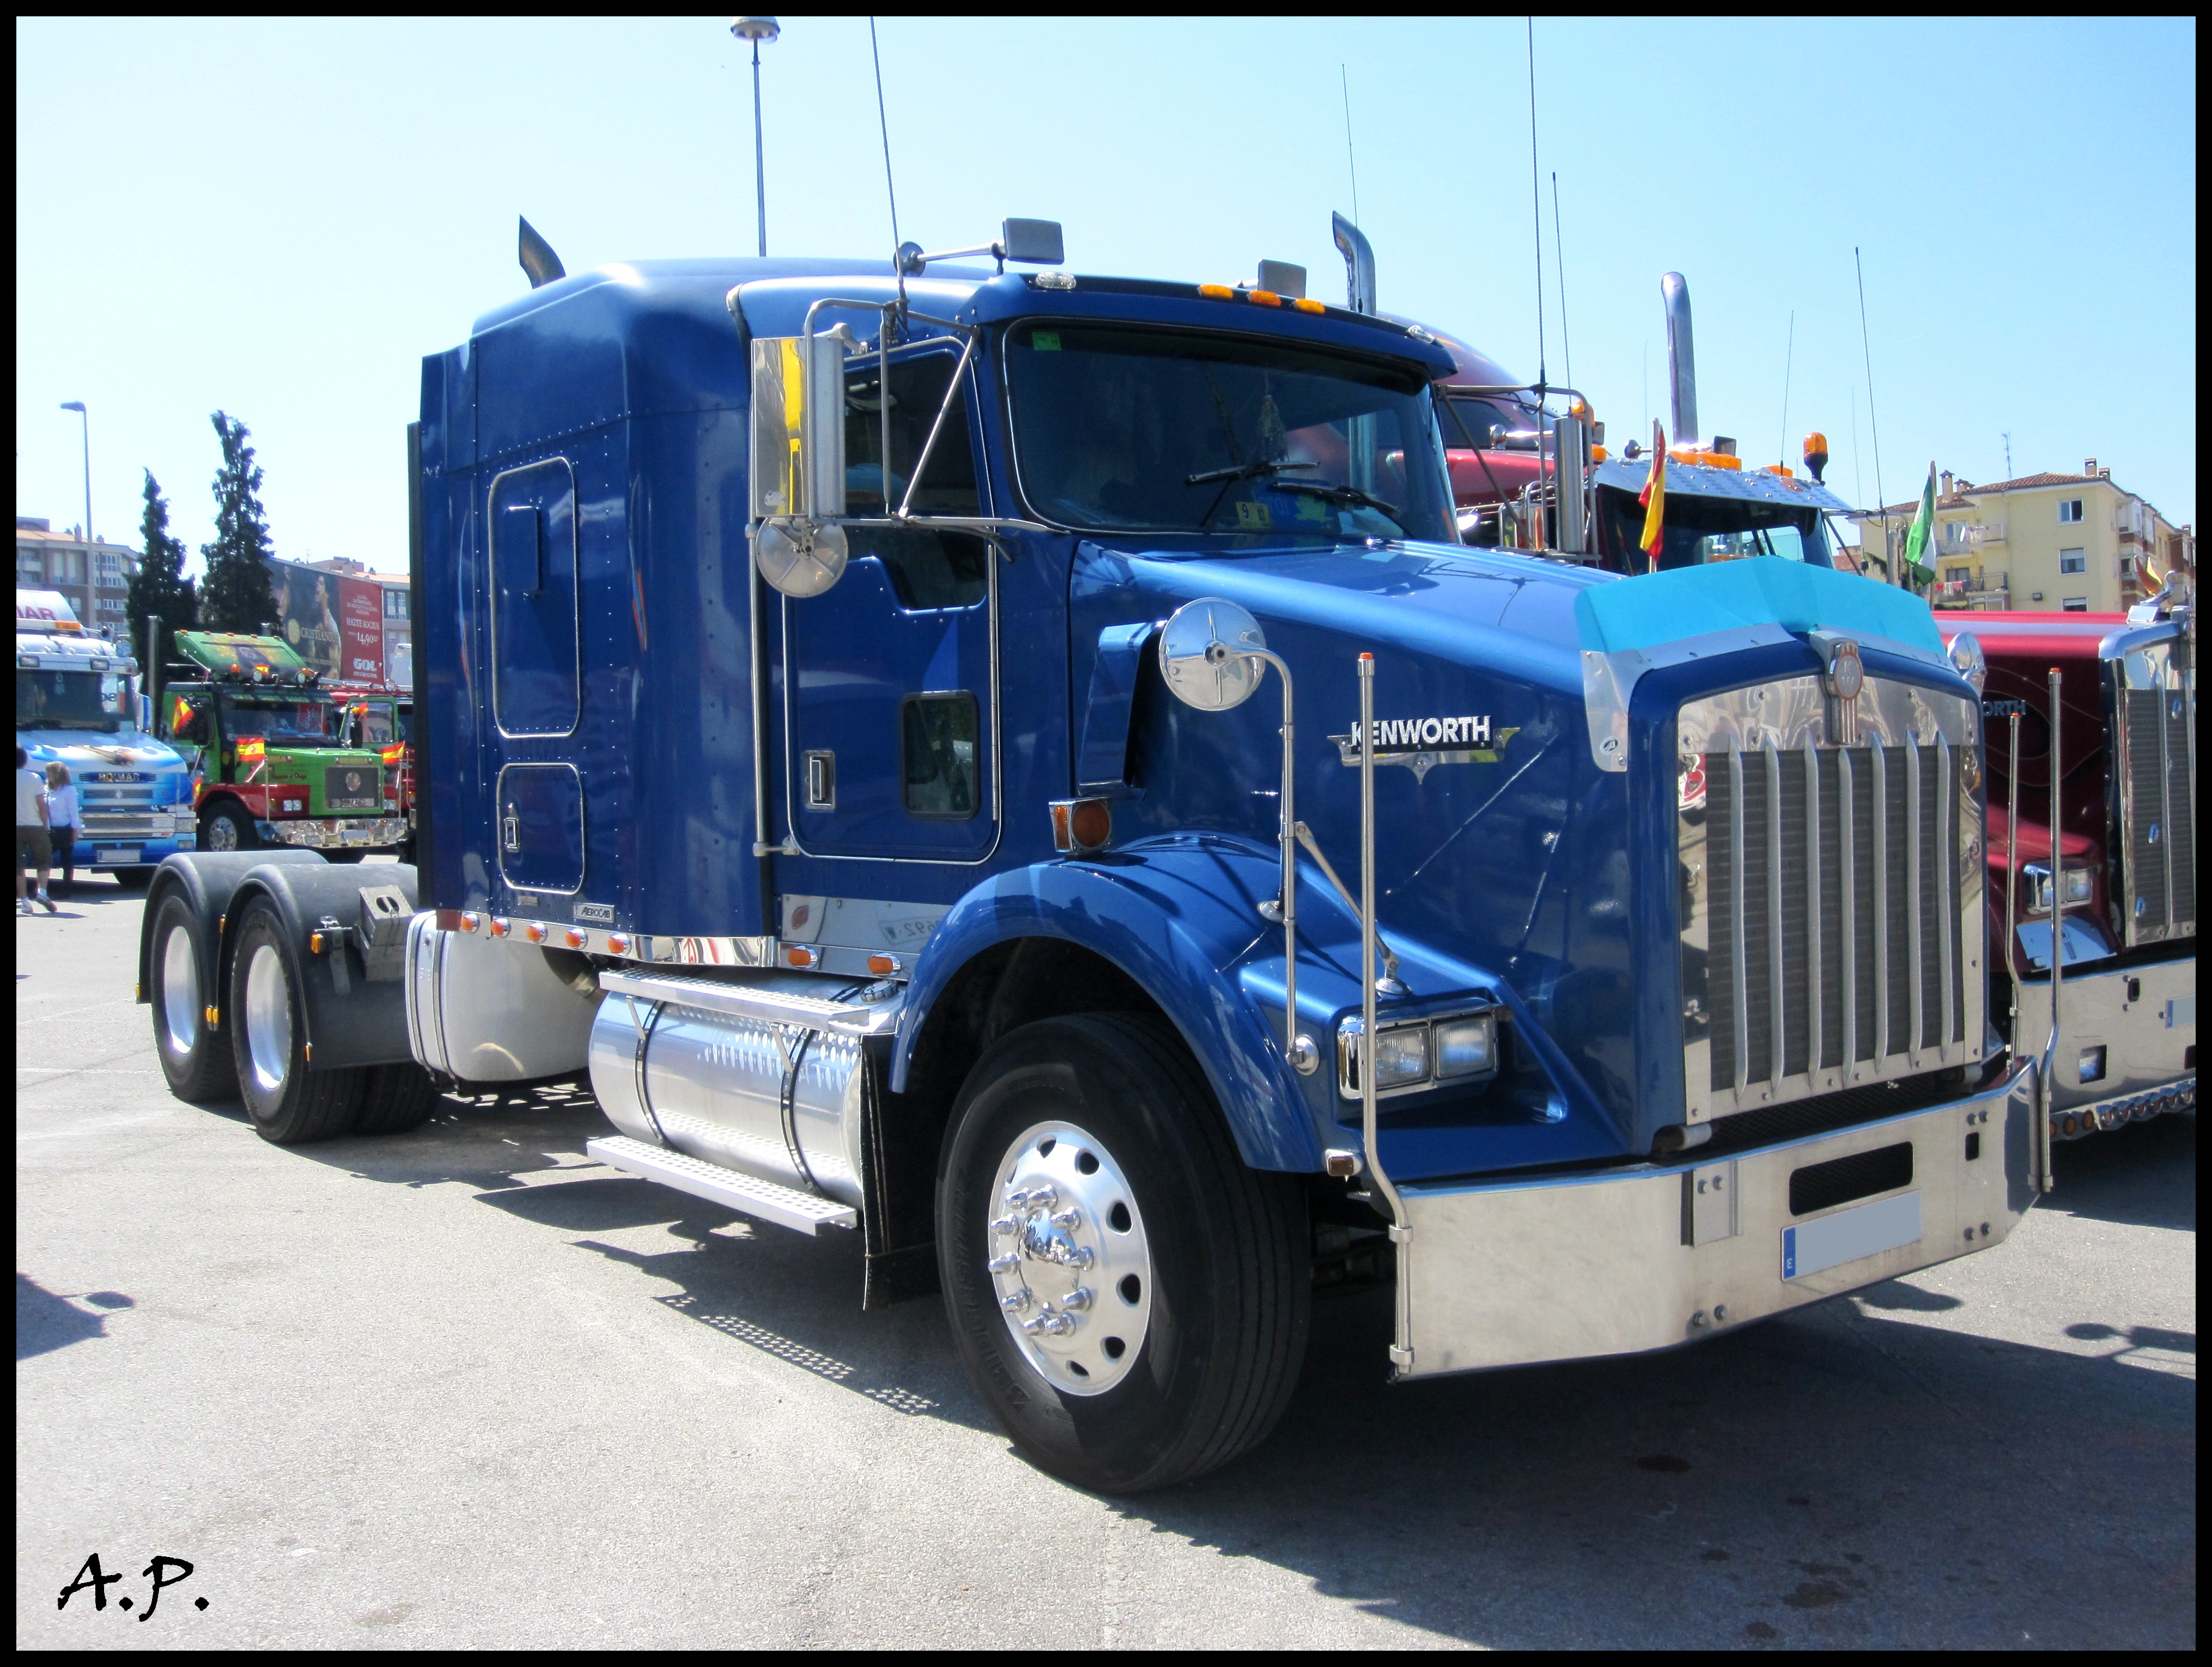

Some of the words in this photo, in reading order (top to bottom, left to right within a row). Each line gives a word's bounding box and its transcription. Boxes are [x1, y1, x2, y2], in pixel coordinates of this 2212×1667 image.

[353, 658, 377, 672] GOL
[1351, 715, 1492, 746] KENWORTH
[581, 906, 611, 918] AEROCAB
[1786, 1258, 1793, 1270] E
